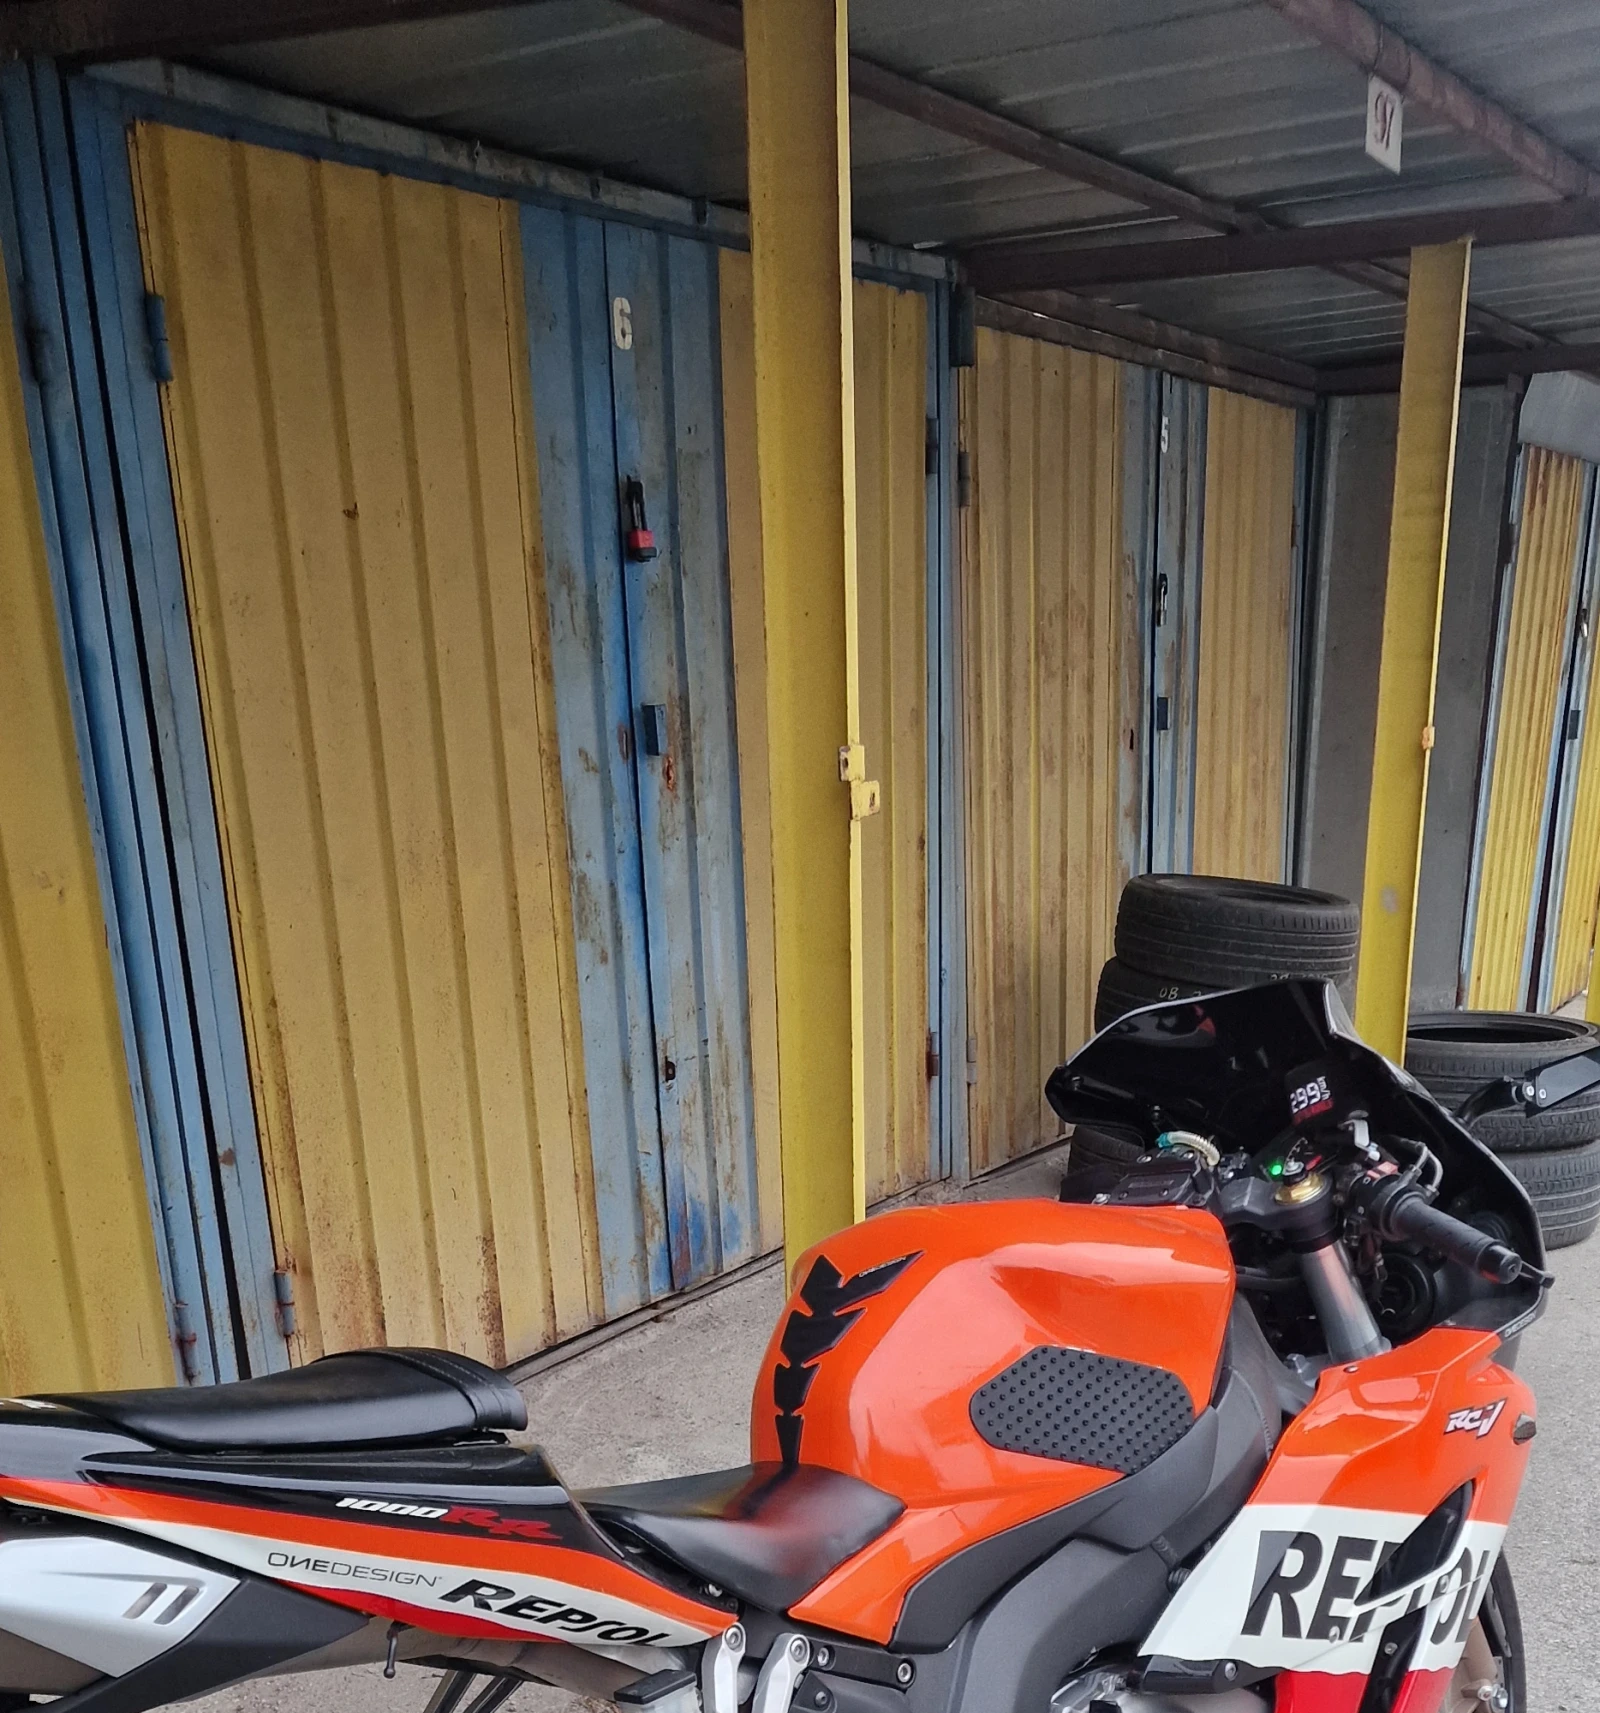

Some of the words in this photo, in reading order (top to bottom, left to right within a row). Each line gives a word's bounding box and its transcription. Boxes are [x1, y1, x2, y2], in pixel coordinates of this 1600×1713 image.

[613, 296, 633, 350] 6
[1160, 415, 1169, 454] 5
[1289, 1082, 1321, 1114] 299
[267, 1552, 439, 1587] ONEDESIGN
[439, 1579, 671, 1646] REPSOL
